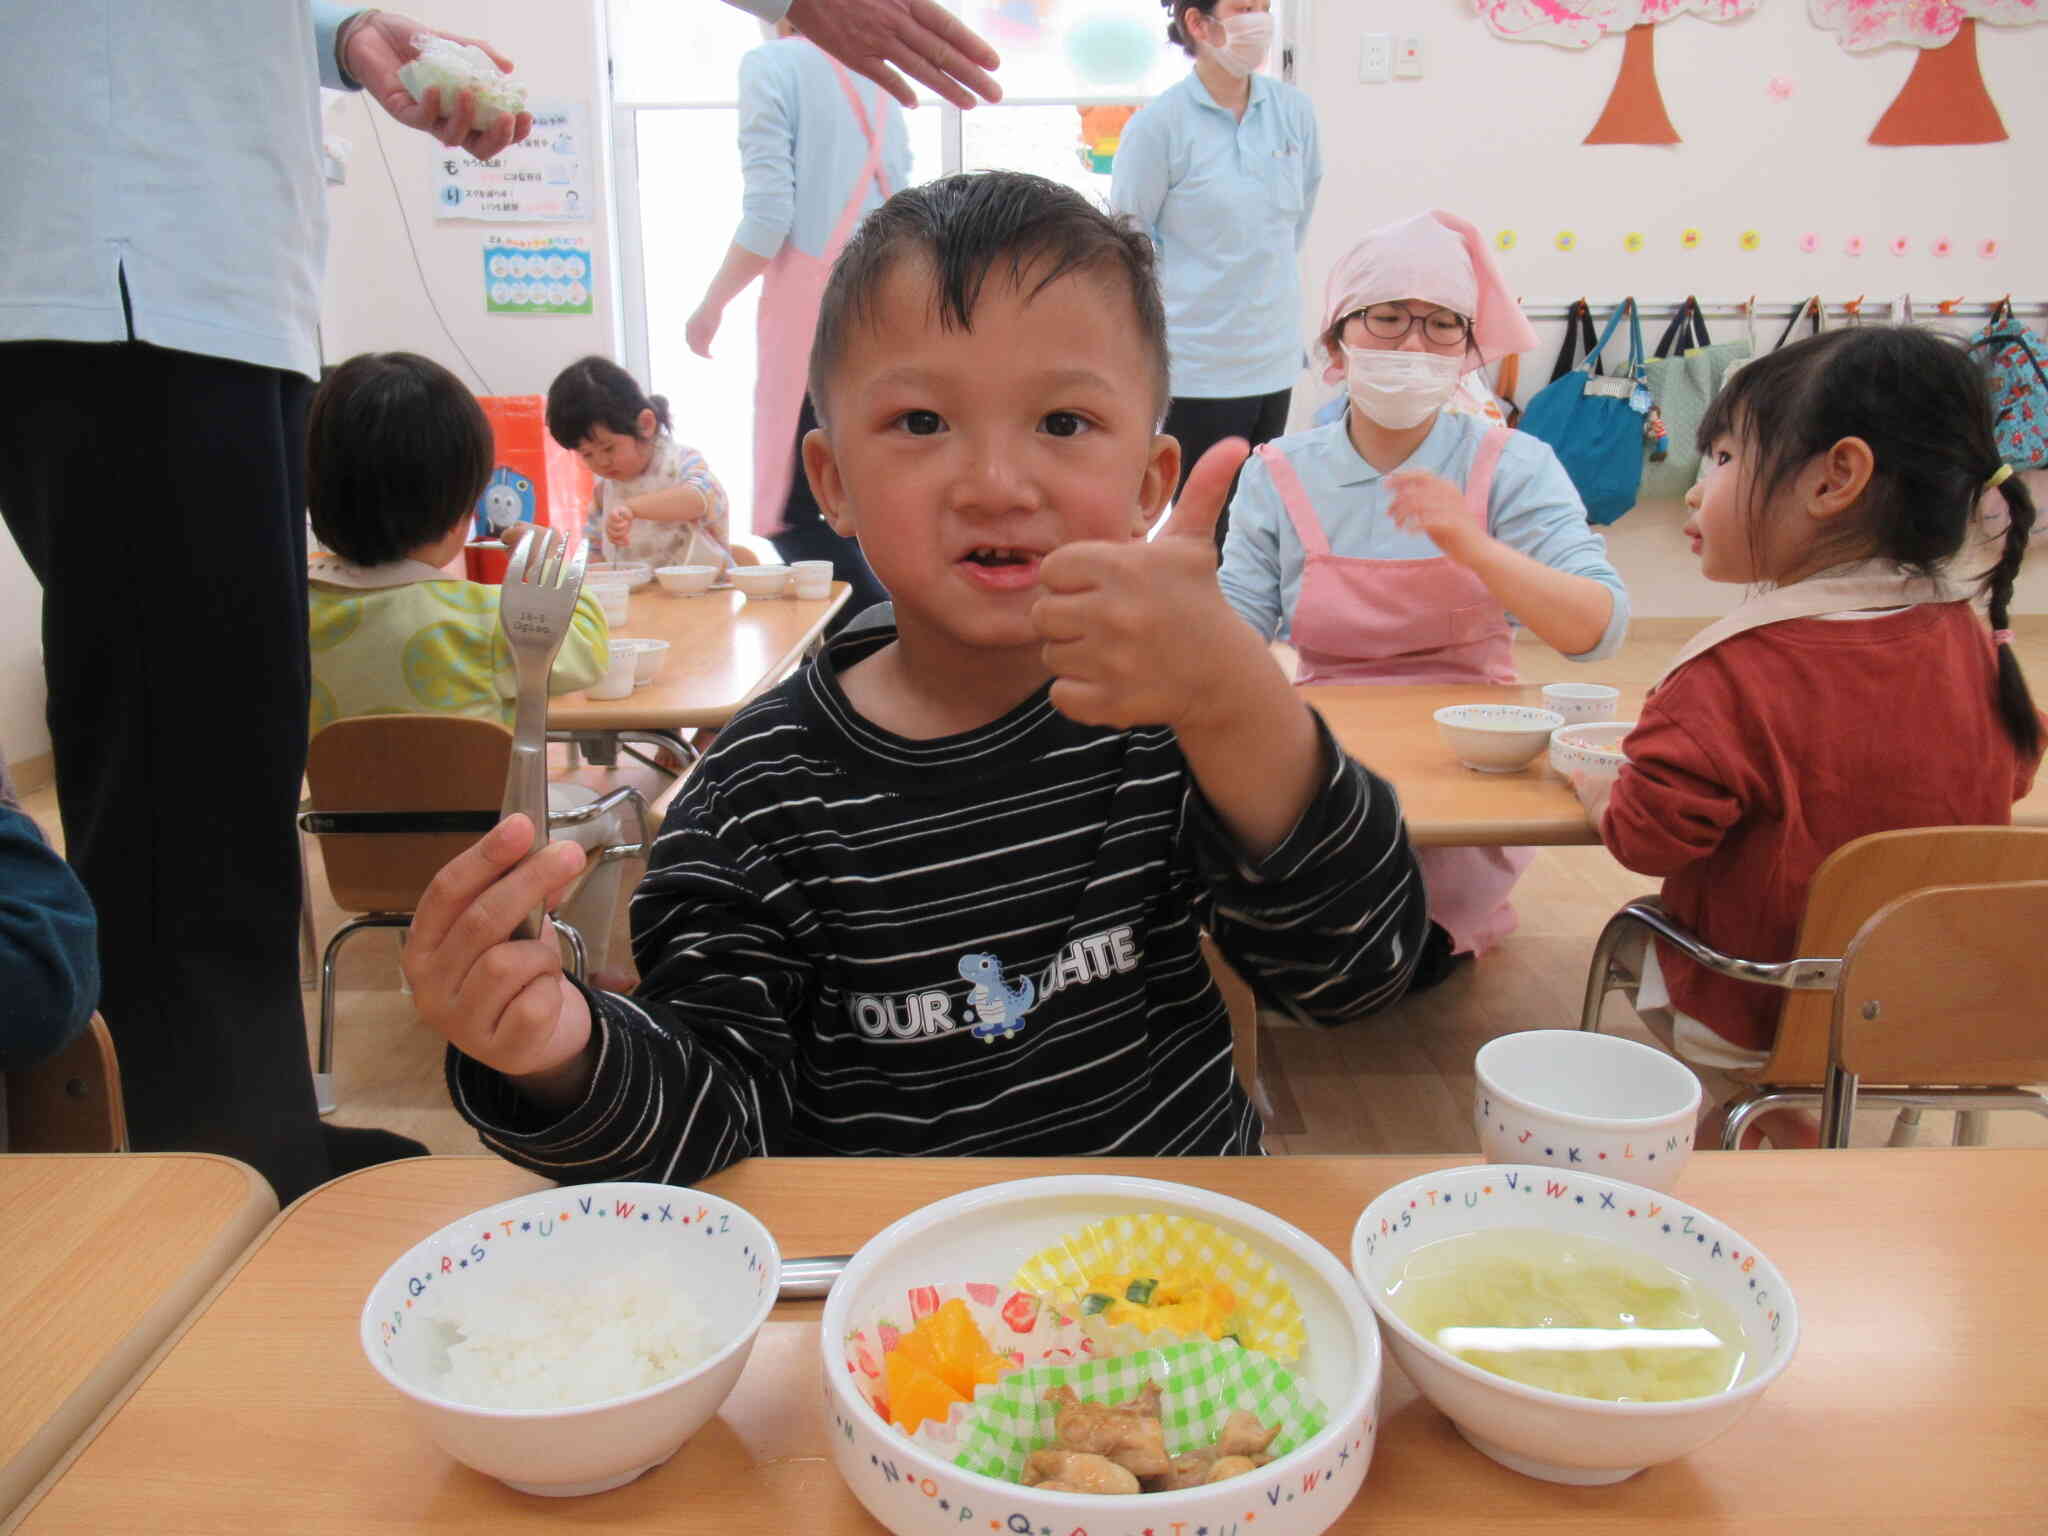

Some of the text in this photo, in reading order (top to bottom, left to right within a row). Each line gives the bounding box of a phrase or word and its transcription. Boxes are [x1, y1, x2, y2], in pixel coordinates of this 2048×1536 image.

[1568, 1147, 1583, 1164] K
[408, 1276, 427, 1297] Q
[440, 1255, 453, 1274] R
[470, 1244, 486, 1263] S
[499, 1219, 515, 1237] T
[578, 1196, 592, 1215] V
[615, 1199, 635, 1219] W
[657, 1203, 673, 1222] X
[719, 1214, 731, 1234] Z
[1401, 1210, 1412, 1228] S
[1426, 1190, 1439, 1207] T
[1505, 1172, 1518, 1190] V
[1546, 1180, 1569, 1199] W
[1599, 1191, 1616, 1209] X
[1680, 1215, 1696, 1234] Z
[1711, 1240, 1722, 1258] A
